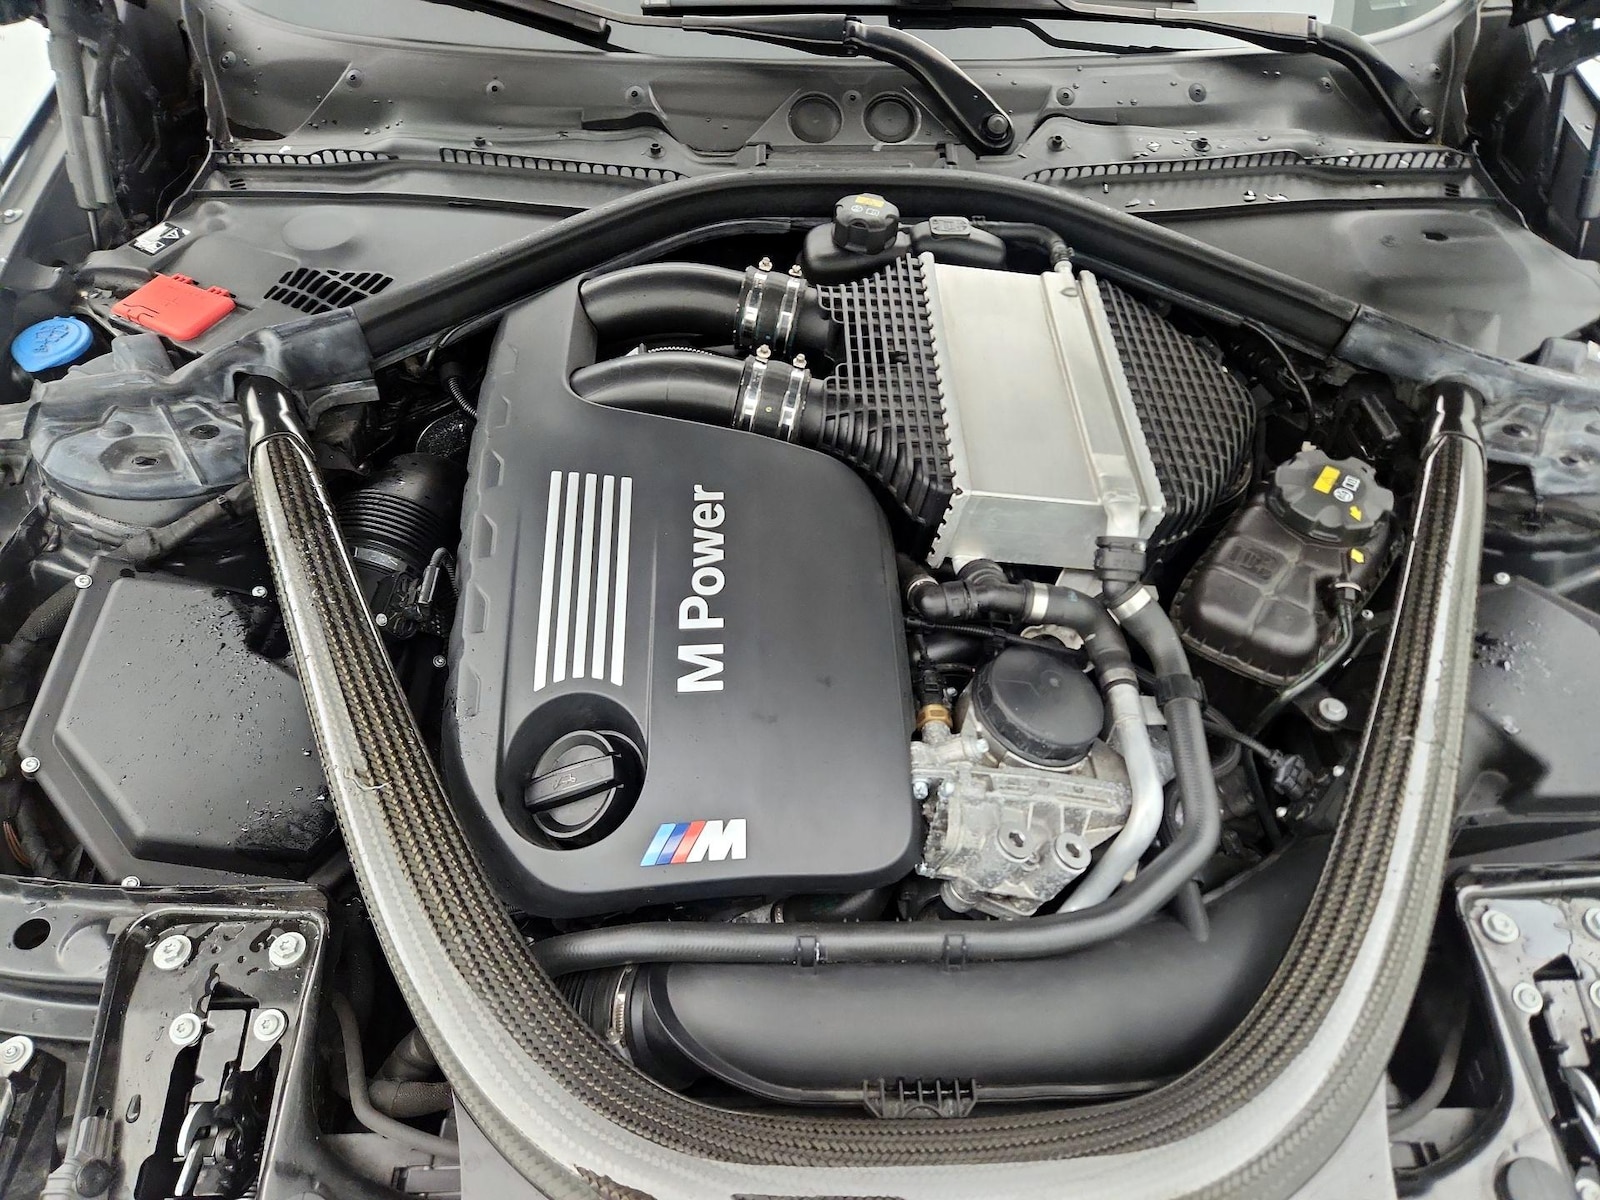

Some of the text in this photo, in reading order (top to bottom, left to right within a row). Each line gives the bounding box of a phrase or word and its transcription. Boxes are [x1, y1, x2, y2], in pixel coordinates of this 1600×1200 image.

[677, 484, 725, 693] M Power
[685, 818, 747, 863] M
